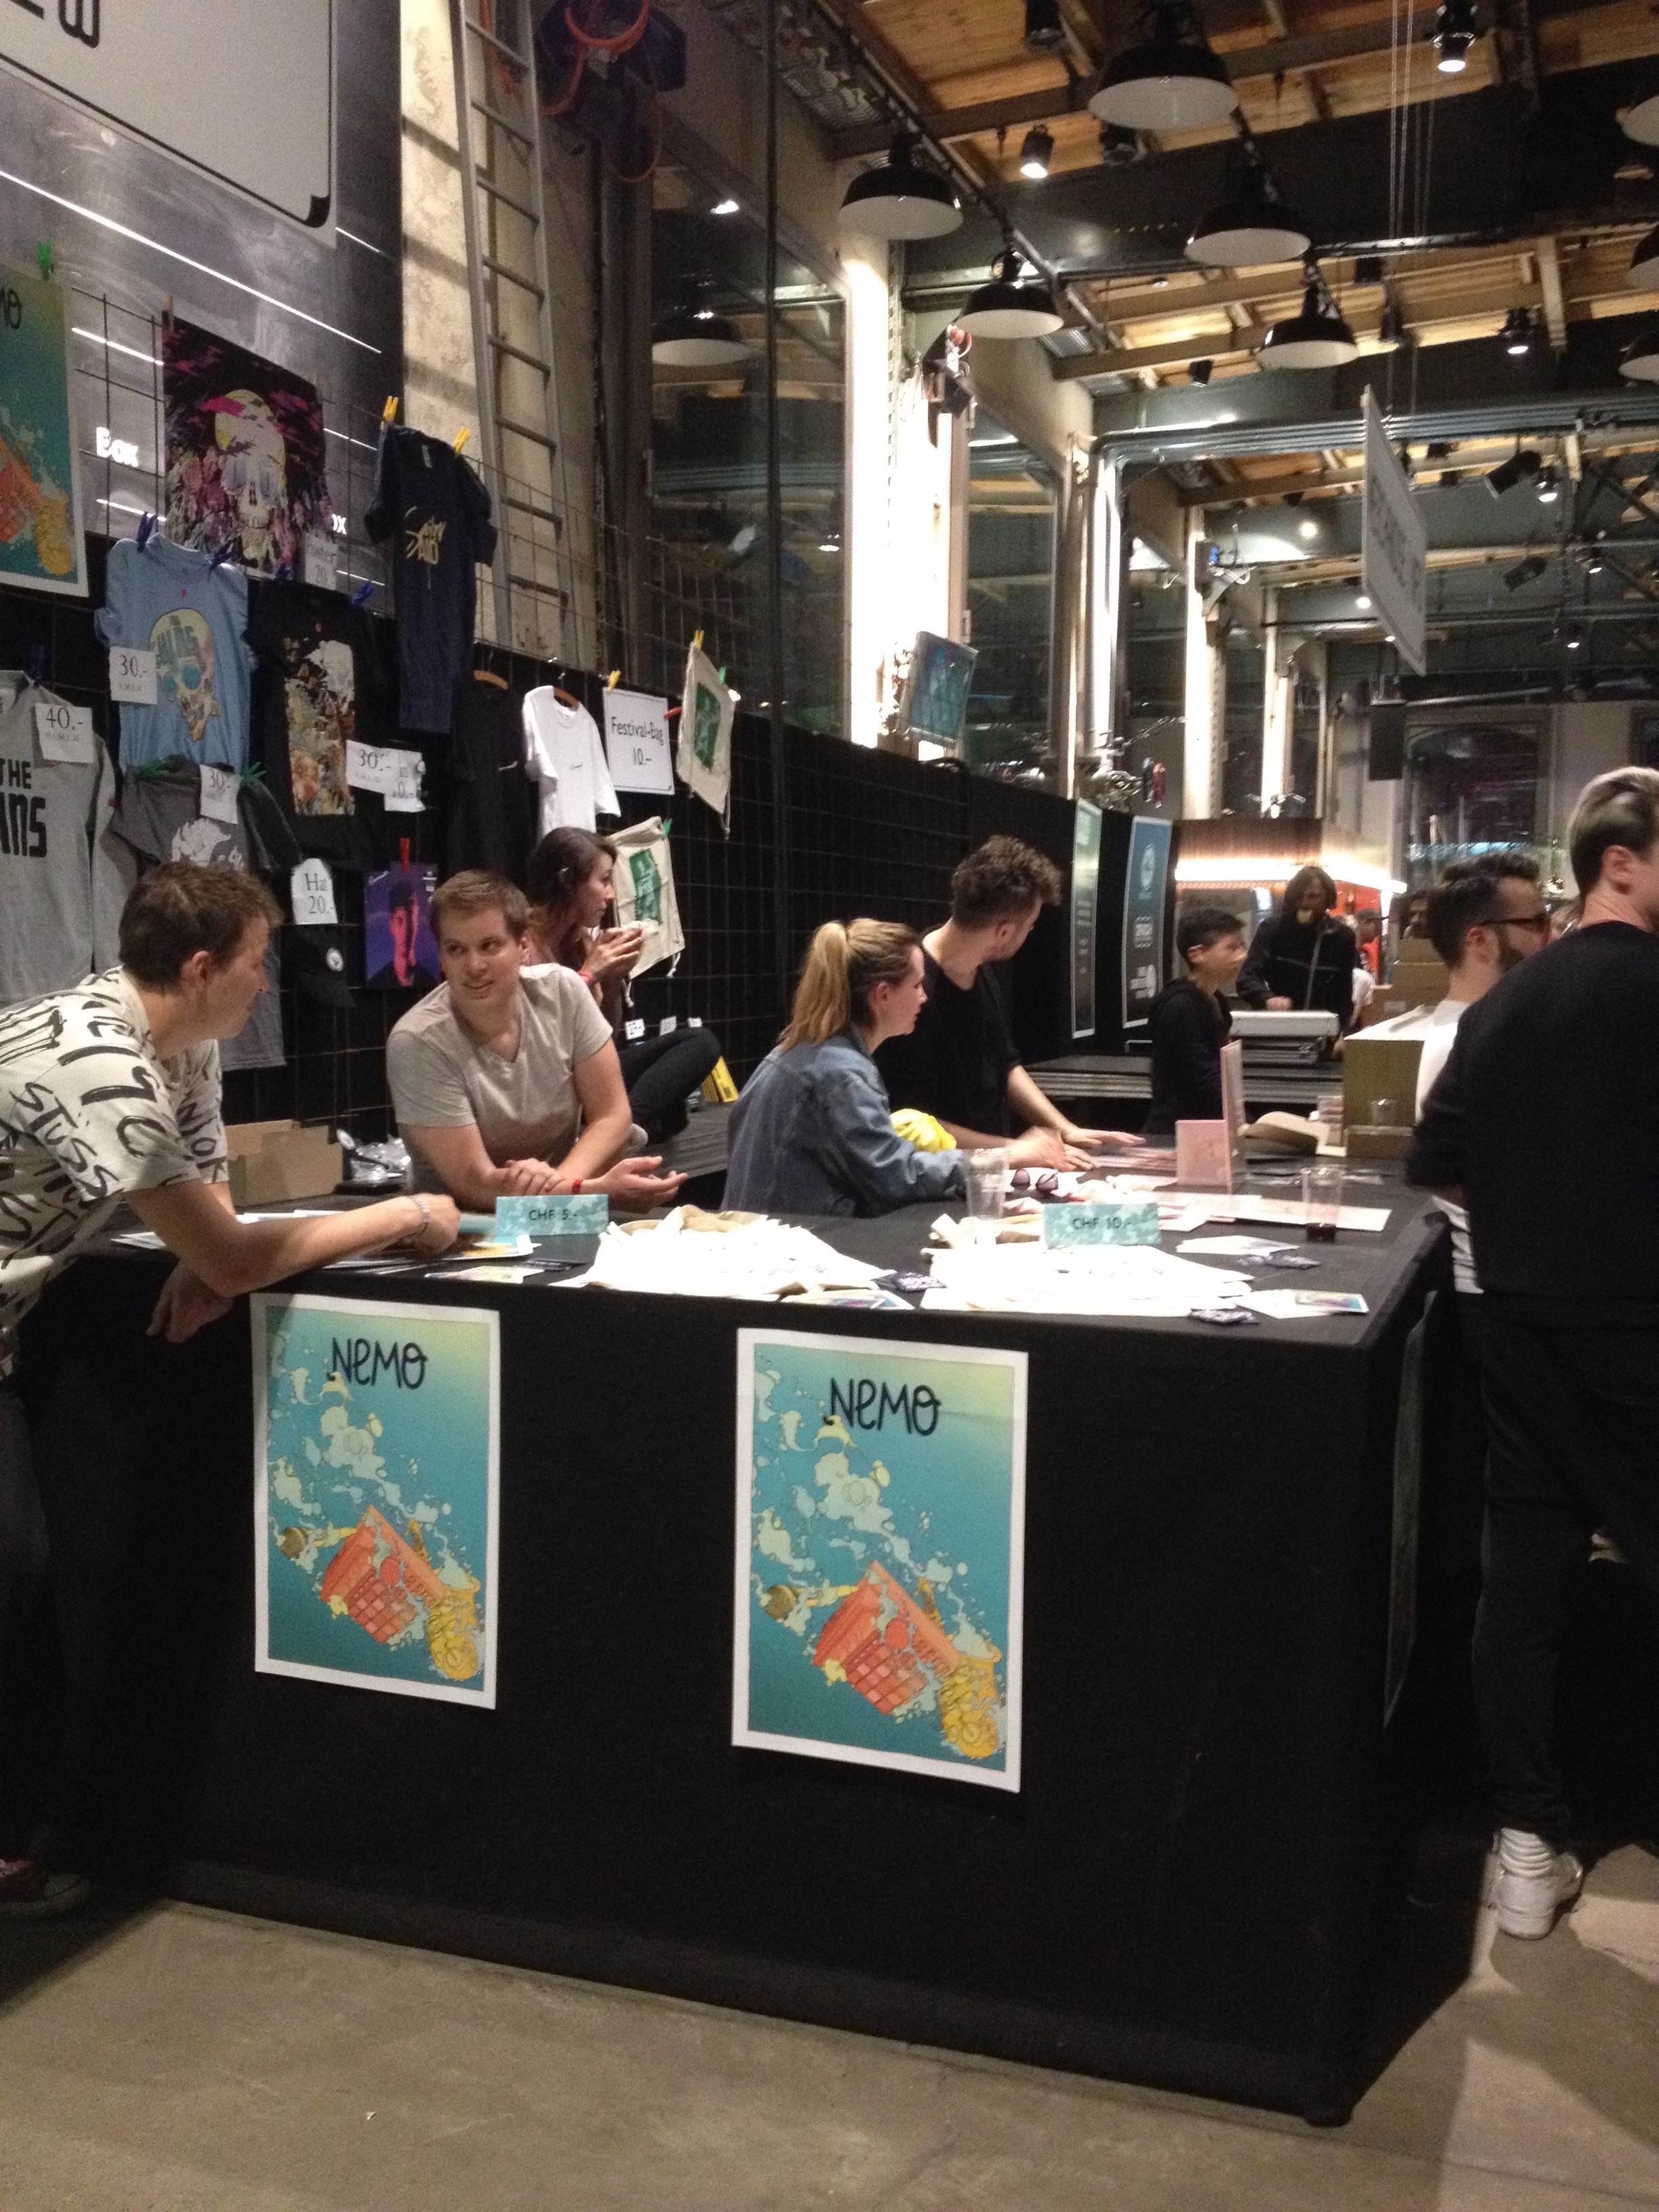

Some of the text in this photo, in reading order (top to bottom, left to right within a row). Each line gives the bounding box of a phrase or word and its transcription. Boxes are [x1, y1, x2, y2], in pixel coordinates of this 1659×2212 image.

[118, 654, 147, 678] 30.-
[45, 708, 83, 730] 40.-
[633, 747, 652, 765] 10.-
[529, 1209, 556, 1221] CHF
[1072, 1217, 1099, 1229] CHF
